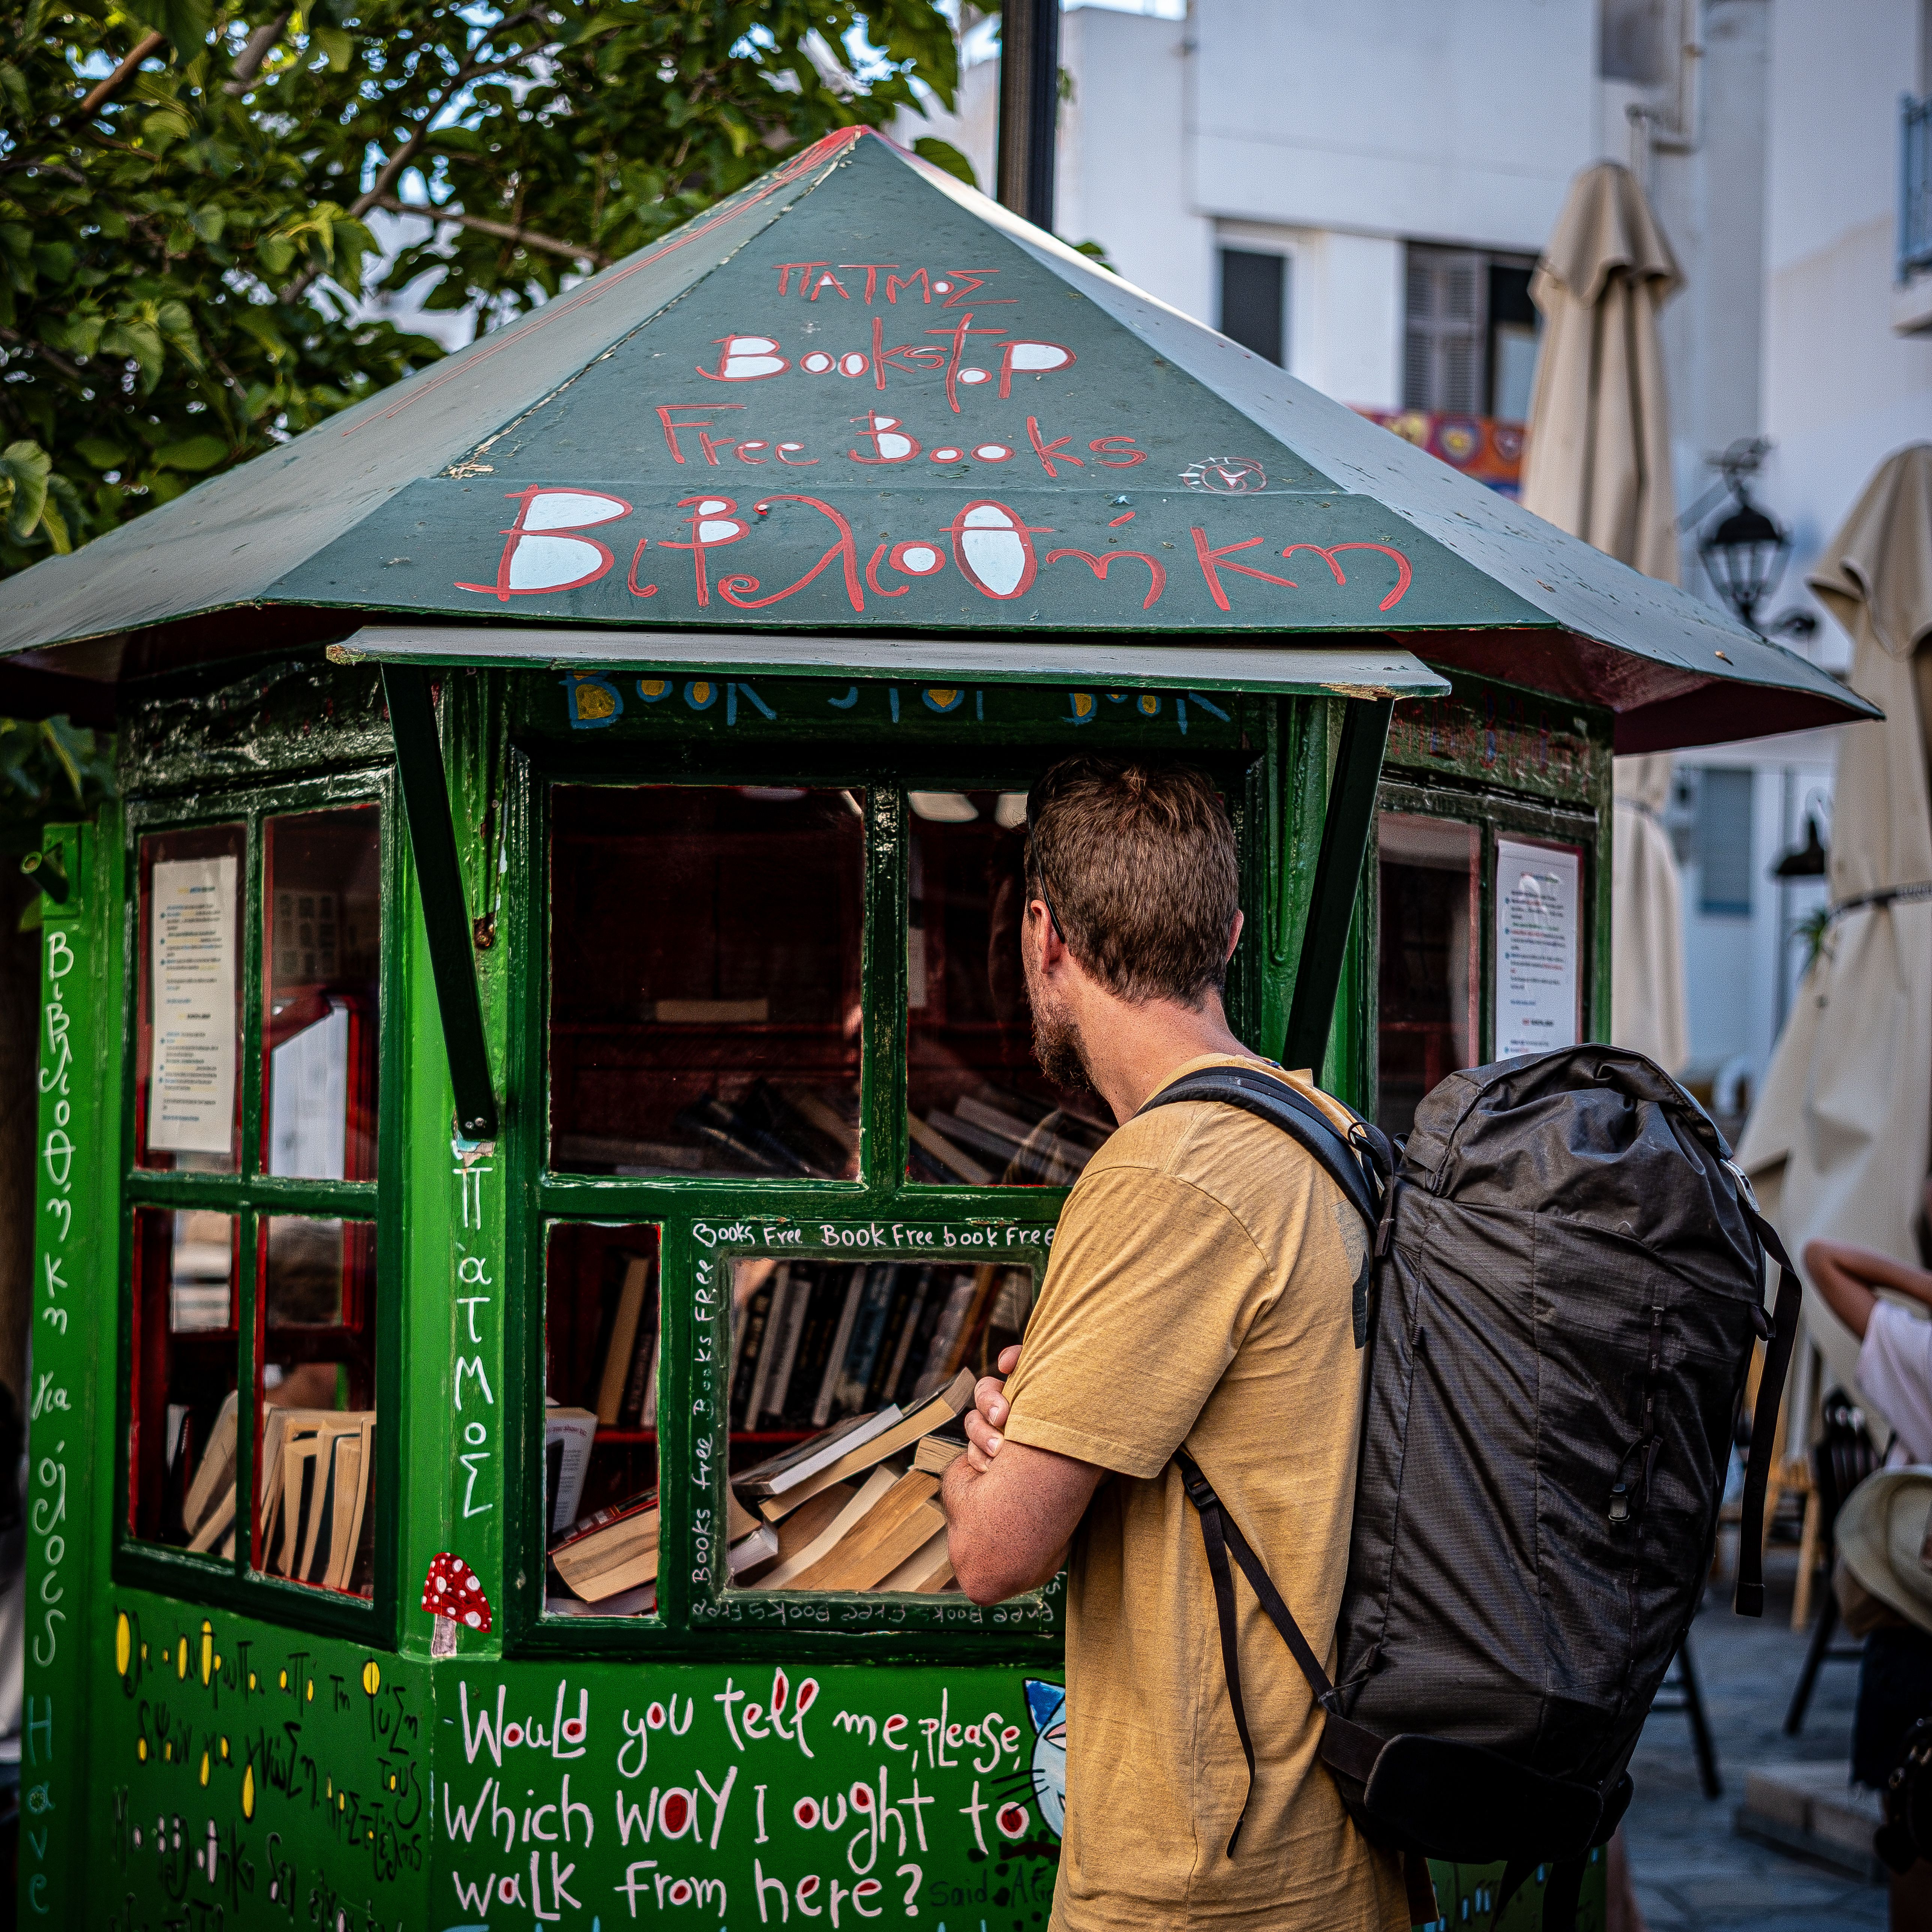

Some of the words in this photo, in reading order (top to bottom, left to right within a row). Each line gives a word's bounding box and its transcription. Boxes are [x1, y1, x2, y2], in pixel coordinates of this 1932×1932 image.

[656, 404, 819, 466] Free
[849, 410, 1147, 477] Books
[693, 1223, 755, 1247] Books
[763, 1227, 802, 1245] Free
[820, 1224, 886, 1246] Book
[892, 1224, 934, 1246] Free
[943, 1223, 997, 1246] book
[692, 1509, 711, 1583] Books
[617, 1694, 692, 1777] you
[715, 1667, 819, 1757] tell
[444, 1775, 593, 1852] Which
[754, 1785, 768, 1843] I
[794, 1766, 934, 1874] ought
[959, 1781, 1029, 1855] to
[615, 1860, 726, 1917] from
[754, 1859, 923, 1928] here?
